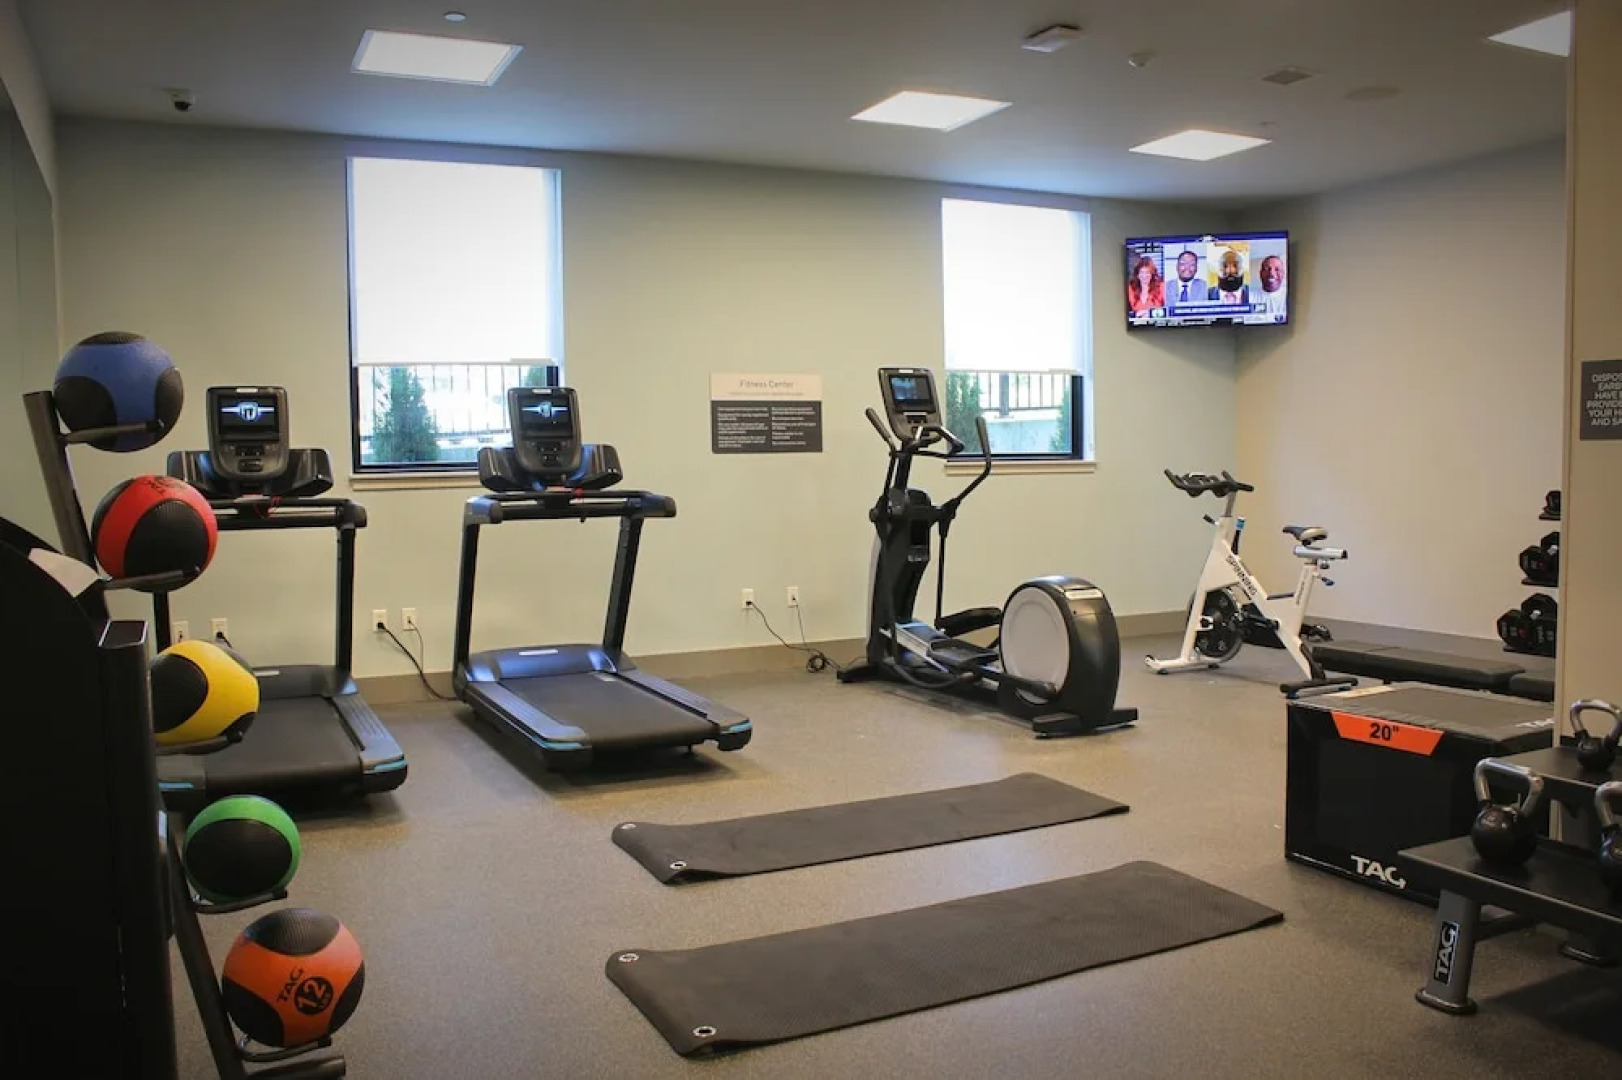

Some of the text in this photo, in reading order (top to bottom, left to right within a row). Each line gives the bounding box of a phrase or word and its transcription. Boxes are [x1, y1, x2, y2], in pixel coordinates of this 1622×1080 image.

[739, 379, 794, 389] Fitness Center
[1594, 391, 1618, 400] HAVE
[1588, 409, 1613, 418] YOUR
[1591, 418, 1611, 426] AND
[1370, 722, 1400, 742] 20"
[1350, 853, 1407, 890] TAG
[1434, 927, 1456, 979] TAG
[275, 966, 304, 1001] TAG
[298, 980, 327, 1009] 12
